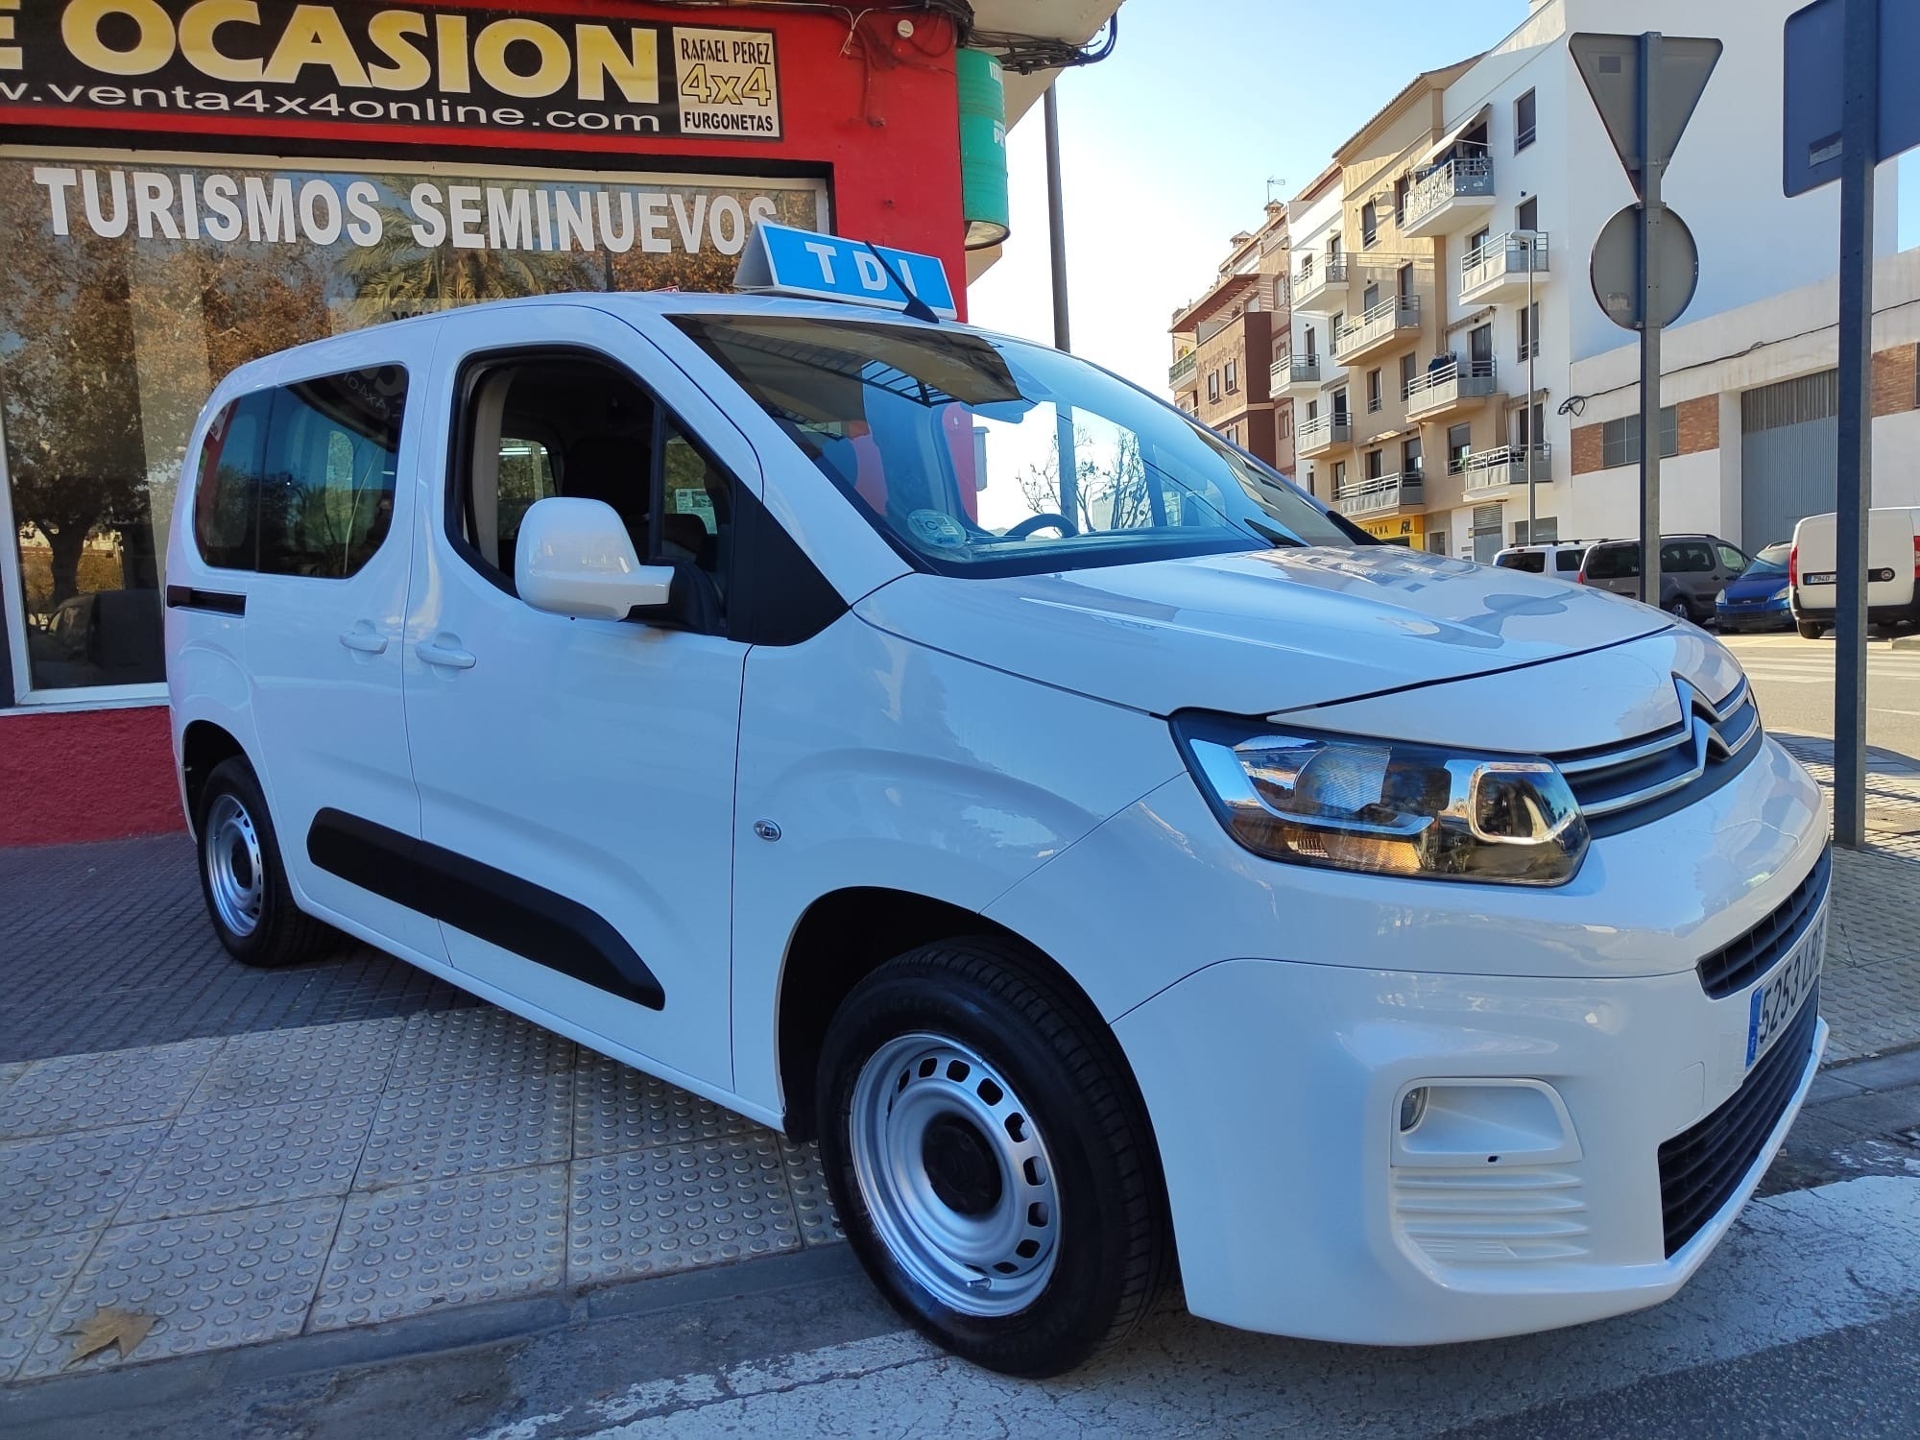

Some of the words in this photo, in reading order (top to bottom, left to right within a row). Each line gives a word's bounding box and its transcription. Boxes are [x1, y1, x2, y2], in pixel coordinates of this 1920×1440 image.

[61, 0, 660, 104] OCASION
[681, 38, 729, 63] RAFAEL
[732, 41, 771, 65] PEREZ
[681, 63, 772, 107] 4x4
[683, 111, 773, 132] FURGONETAS
[34, 167, 384, 248] TURISMOS
